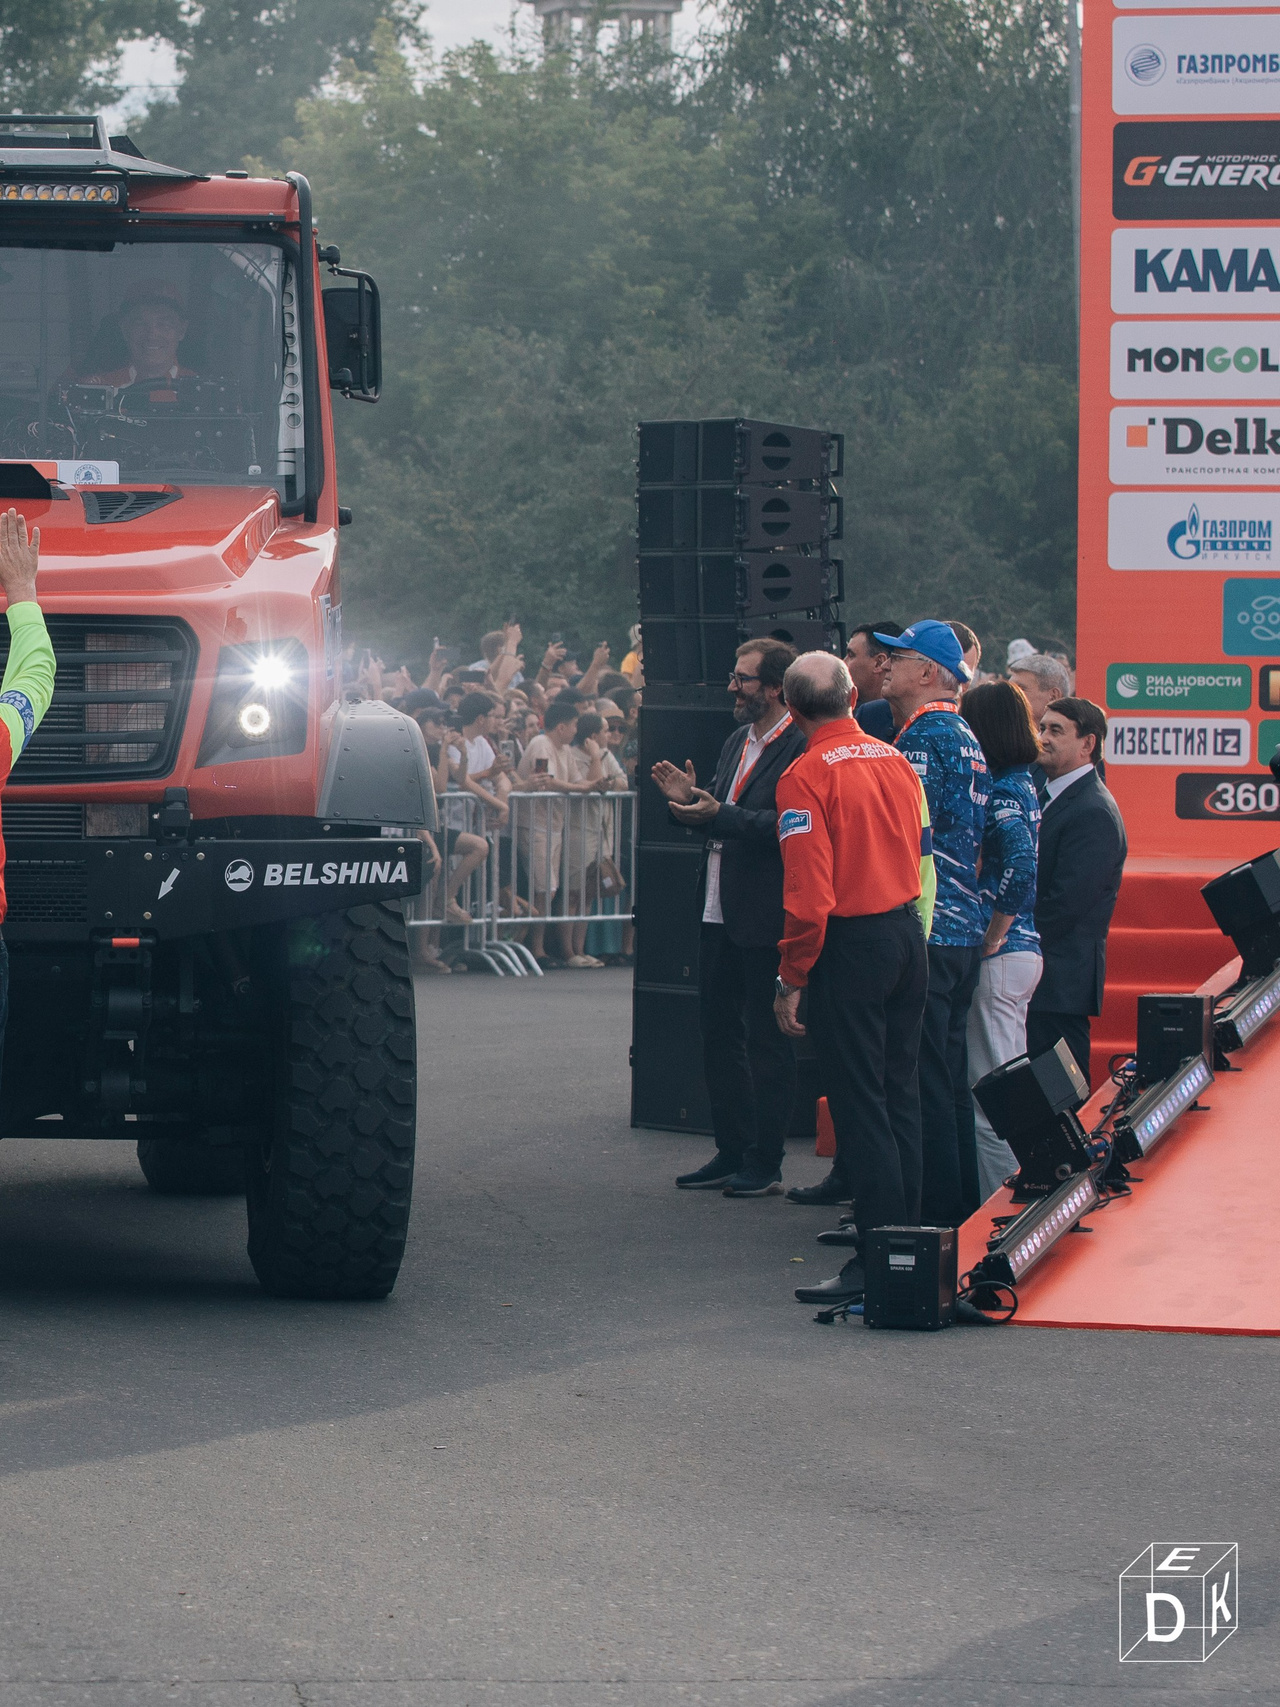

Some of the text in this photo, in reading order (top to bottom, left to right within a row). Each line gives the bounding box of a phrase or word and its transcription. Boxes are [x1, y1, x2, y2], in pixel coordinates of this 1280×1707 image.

[1205, 155, 1278, 163] МОТОРНОЕ
[1165, 467, 1250, 475] ТРАНСПОРТНАЯ
[1202, 520, 1272, 538] ГАЗПРОМ
[1203, 541, 1272, 551] ДОБЫЧА
[1201, 553, 1272, 561] ИРКУТСК
[1146, 675, 1242, 688] РИА НОВОСТИ
[1145, 686, 1191, 697] СПОРТ
[1114, 727, 1207, 756] ИЗВЕСТИЯ
[908, 751, 928, 761] VTB
[263, 861, 409, 887] BELSHINA
